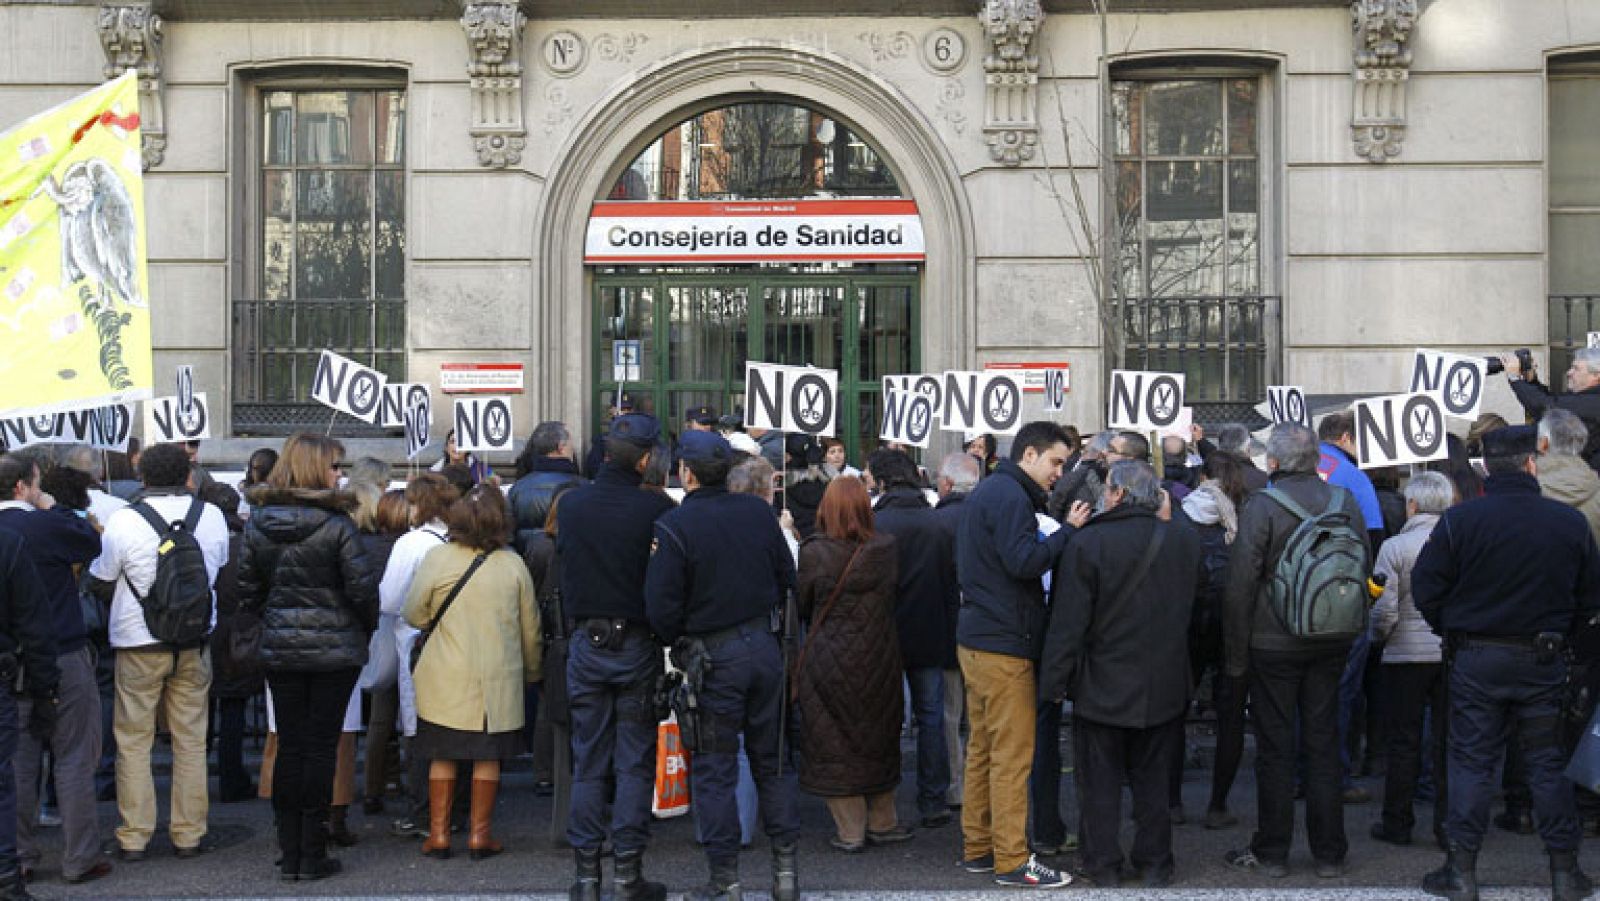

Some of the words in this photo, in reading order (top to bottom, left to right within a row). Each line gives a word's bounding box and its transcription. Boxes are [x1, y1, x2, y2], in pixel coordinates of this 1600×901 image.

[607, 224, 747, 252] Consejería
[755, 224, 788, 247] de
[796, 223, 903, 247] Sanidad
[315, 354, 382, 415] NO
[746, 367, 833, 434] NO
[943, 373, 1021, 431] NO
[1044, 370, 1064, 410] NO
[1111, 373, 1181, 426] NO
[1269, 388, 1306, 425] NO
[1411, 354, 1481, 415] NO
[405, 403, 429, 455] NO
[455, 399, 511, 449] NO
[883, 391, 932, 443] NO
[1359, 395, 1442, 464] NO
